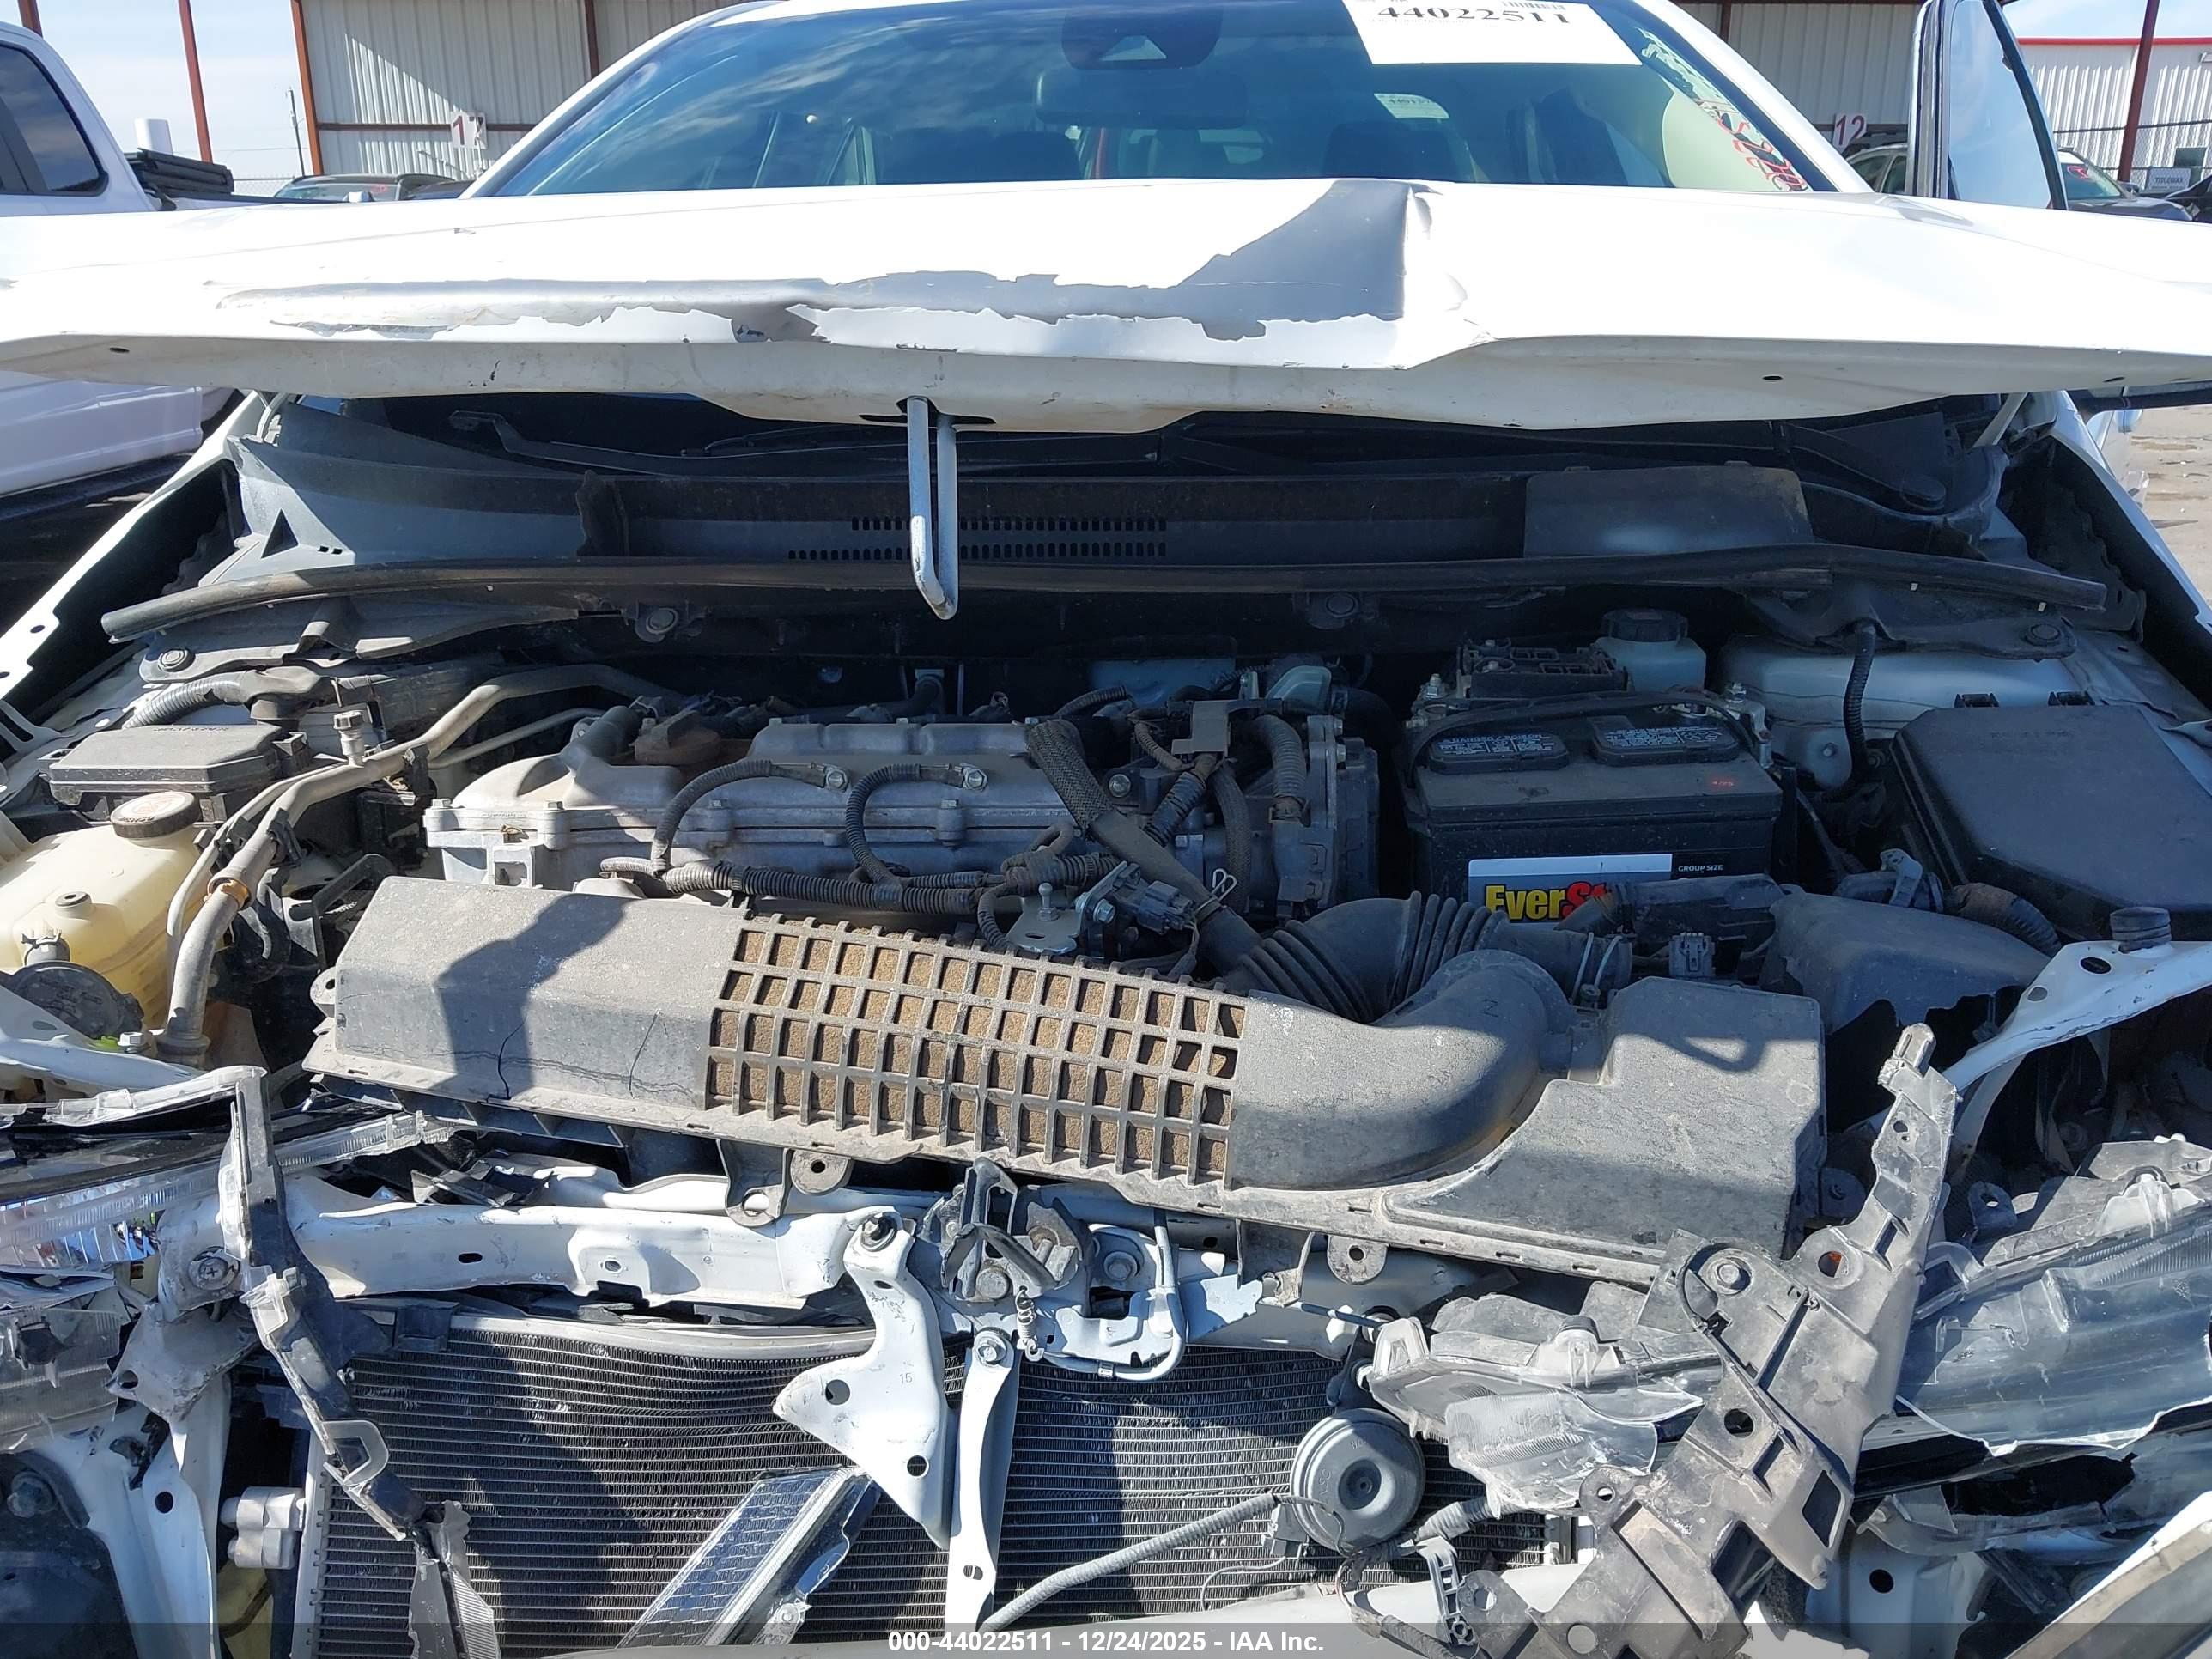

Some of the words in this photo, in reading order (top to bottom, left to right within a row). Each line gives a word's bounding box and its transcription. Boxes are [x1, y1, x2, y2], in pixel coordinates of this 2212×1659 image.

[1377, 6, 1571, 24] 44022511
[1836, 115, 1865, 146] 12
[899, 1372, 914, 1384] 15
